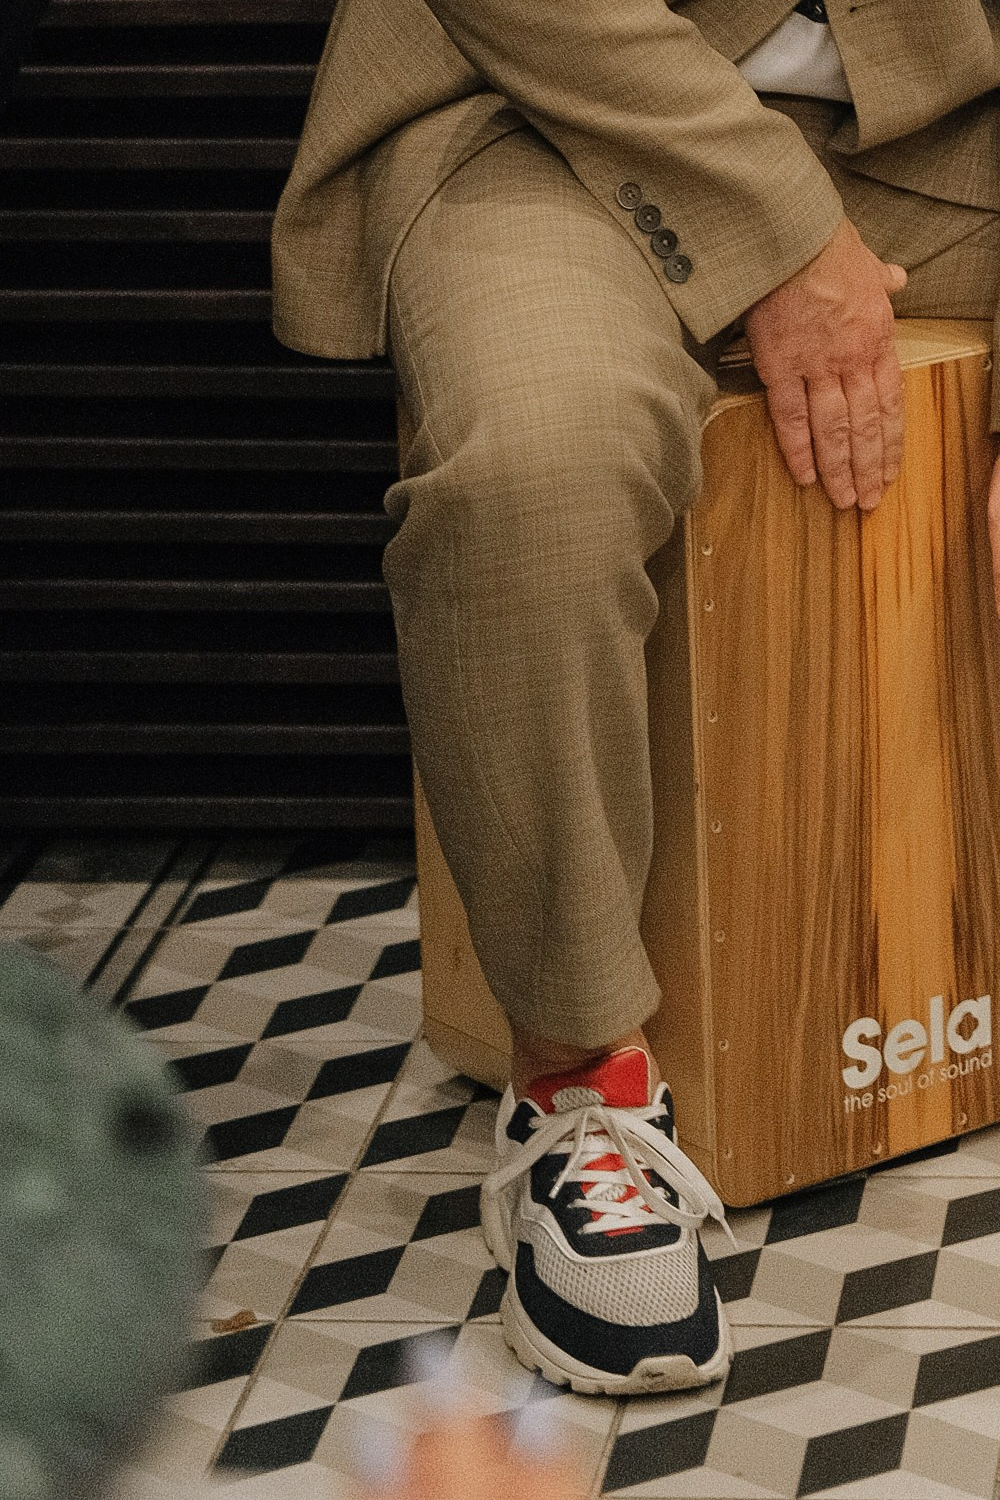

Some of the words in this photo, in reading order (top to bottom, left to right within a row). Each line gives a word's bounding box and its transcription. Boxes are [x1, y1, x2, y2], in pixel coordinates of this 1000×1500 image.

[844, 1092, 874, 1113] the
[877, 1076, 913, 1104] soul
[918, 1070, 936, 1090] of
[940, 1049, 993, 1082] sound
